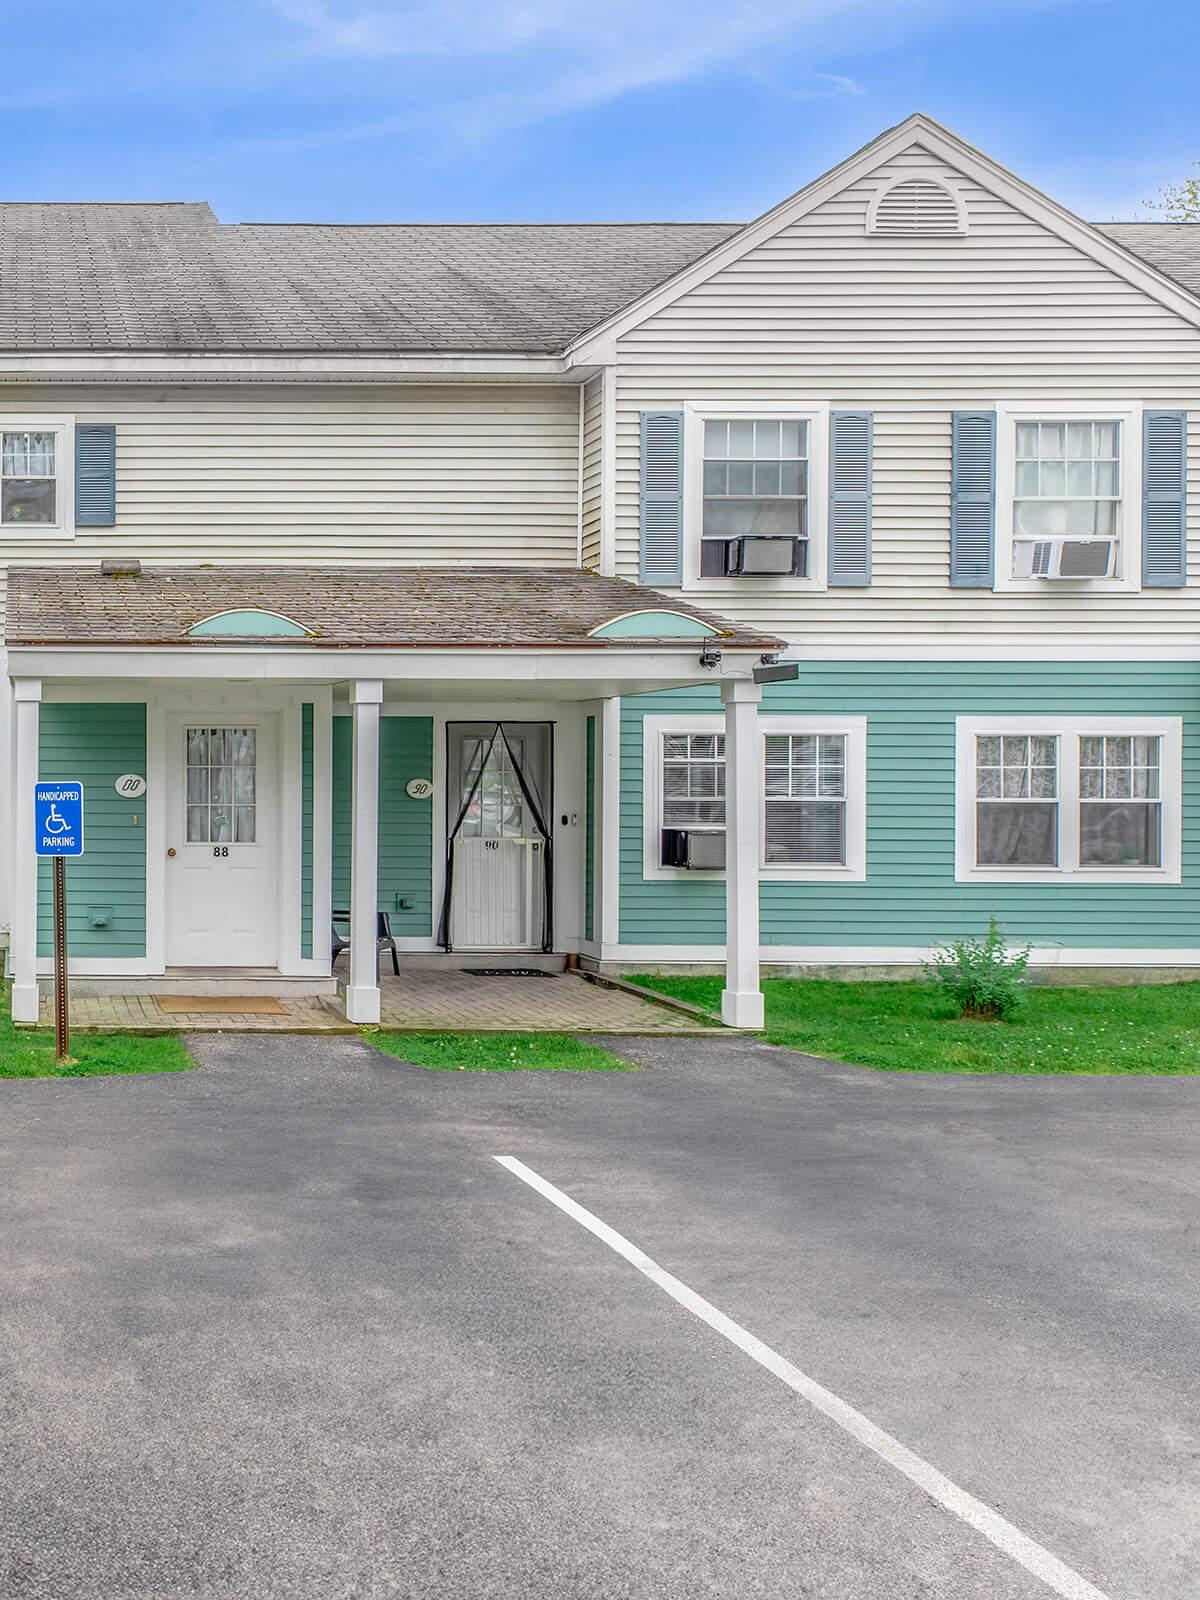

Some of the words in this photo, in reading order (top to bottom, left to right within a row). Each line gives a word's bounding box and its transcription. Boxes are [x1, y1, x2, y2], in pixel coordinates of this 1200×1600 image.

[412, 784, 428, 795] 90
[38, 792, 79, 801] HANDICAPPED
[43, 837, 75, 847] PARKING
[213, 846, 229, 857] 88
